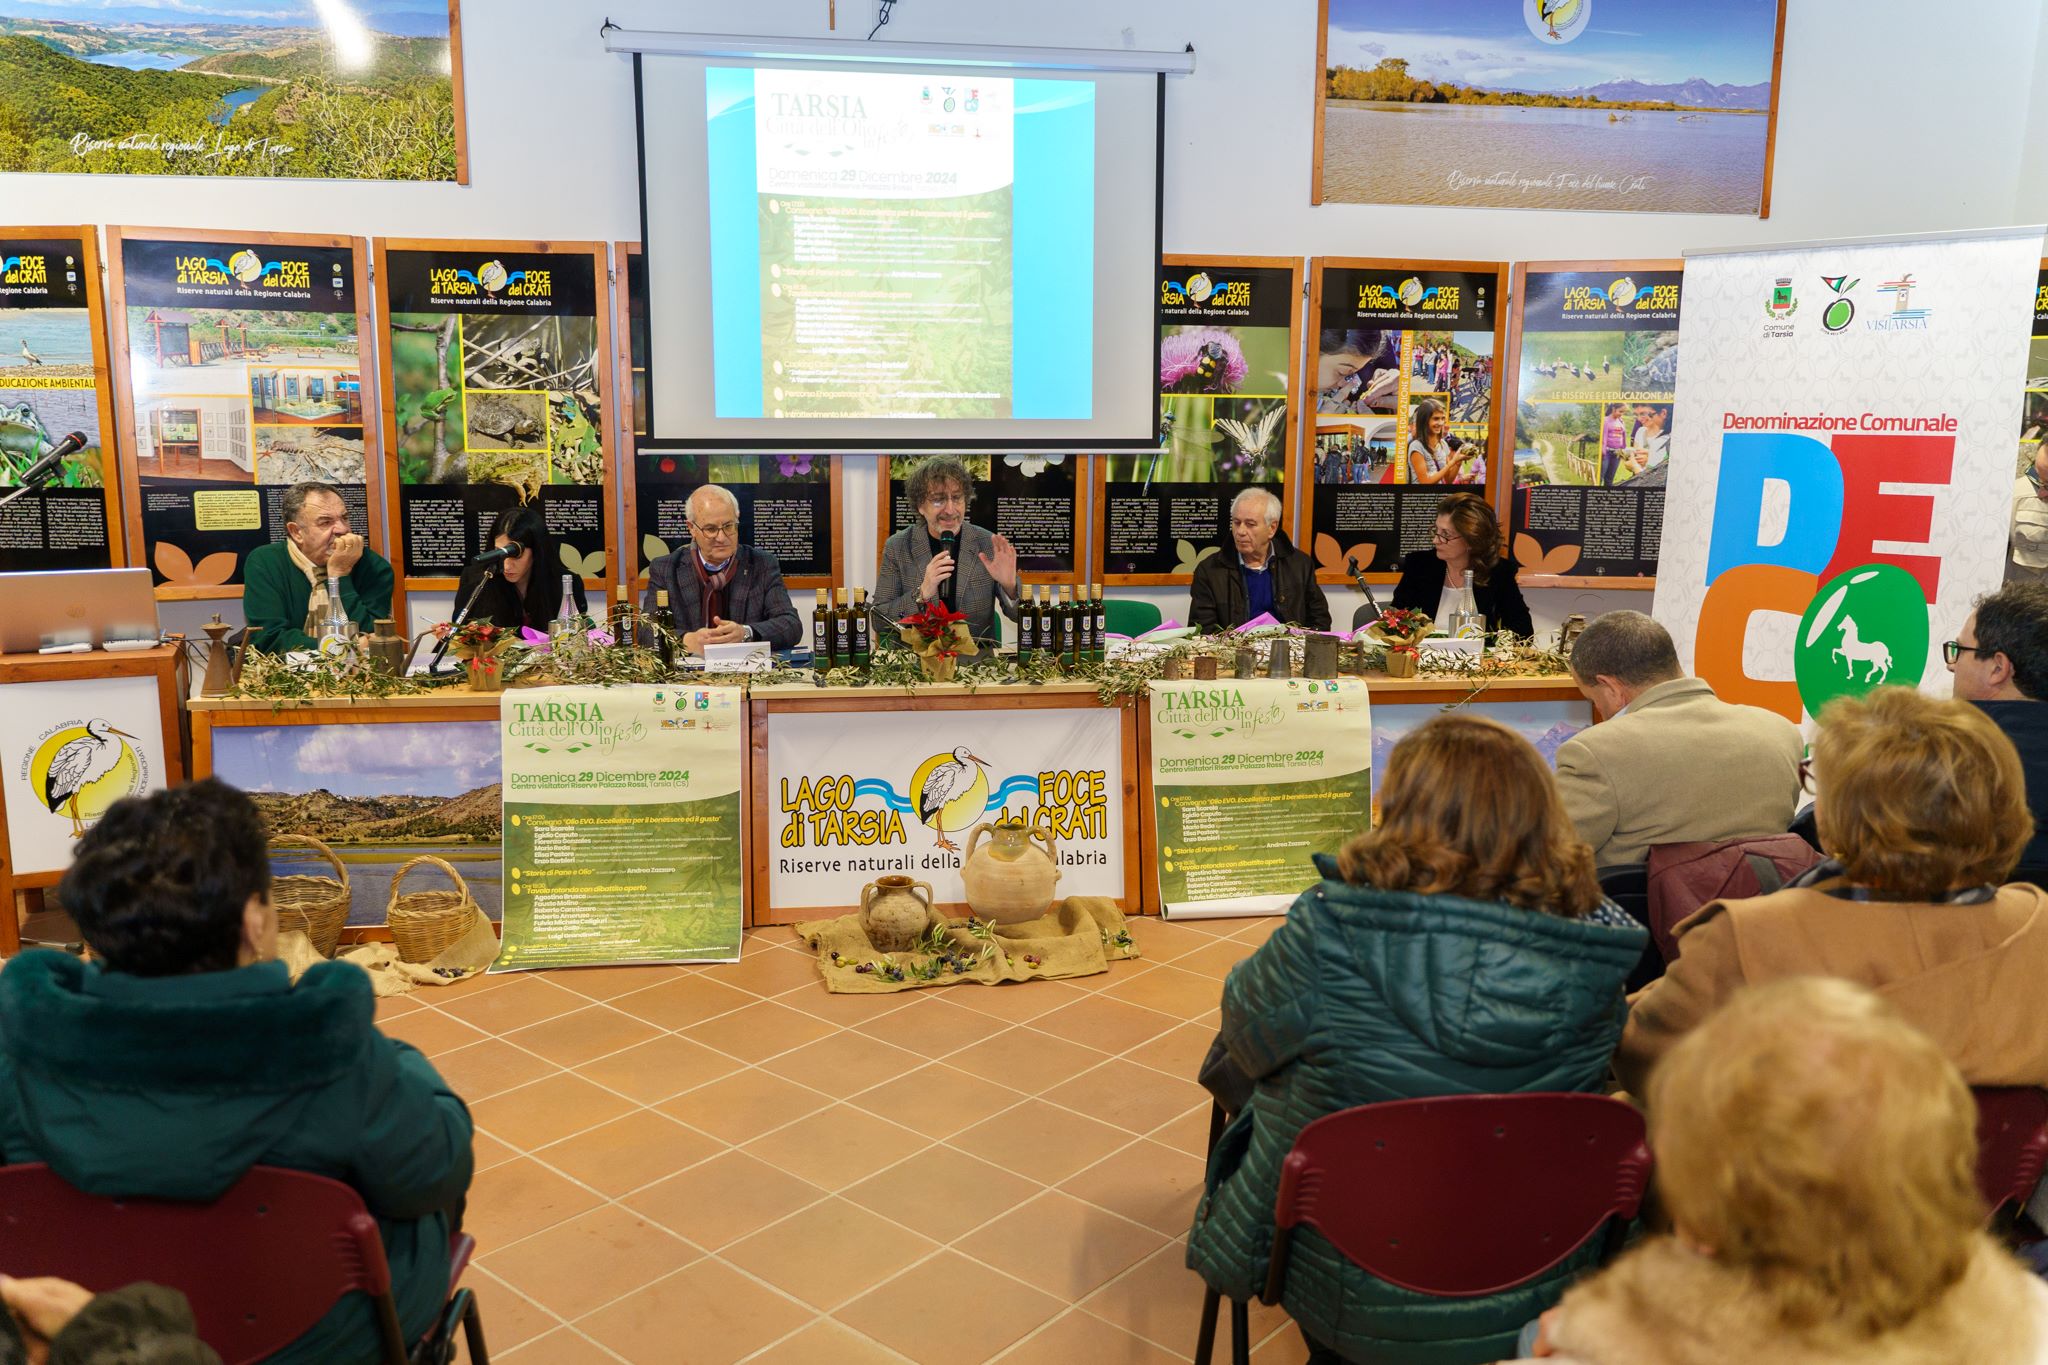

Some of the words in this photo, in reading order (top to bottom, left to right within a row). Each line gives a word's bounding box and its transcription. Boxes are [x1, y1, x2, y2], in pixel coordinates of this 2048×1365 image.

[771, 92, 868, 118] TARSIA
[840, 169, 857, 181] 29
[926, 171, 958, 184] 2024
[20, 256, 46, 270] FOCE
[176, 256, 207, 271] LAGO
[282, 261, 310, 275] FOCE
[5, 271, 19, 284] del
[19, 270, 47, 284] CRATI
[177, 272, 187, 284] di
[187, 272, 230, 285] TARSIA
[263, 274, 279, 287] del
[280, 274, 310, 288] CRATI
[430, 268, 458, 282] LAGO
[525, 271, 551, 284] FOCE
[177, 287, 203, 295] Riserve
[254, 290, 282, 299] Regione
[431, 282, 440, 294] di
[441, 282, 477, 295] TARSIA
[508, 283, 522, 295] del
[523, 283, 552, 296] CRATI
[1228, 282, 1250, 295] FOCE
[1359, 285, 1382, 298] LAGO
[1438, 287, 1460, 299] FOCE
[1564, 287, 1589, 298] LAGO
[1653, 285, 1678, 298] FOCE
[499, 299, 525, 307] Regione
[1161, 293, 1185, 305] RSIA
[1212, 294, 1224, 306] del
[1225, 294, 1250, 306] CRATI
[1357, 297, 1367, 309] di
[1367, 297, 1397, 309] TARSIA
[1422, 298, 1434, 310] del
[1435, 299, 1459, 310] CRATI
[1563, 299, 1571, 310] di
[1572, 298, 1606, 310] TARSIA
[1636, 298, 1649, 310] del
[1650, 298, 1677, 310] CRATI
[1763, 324, 1795, 332] Comune
[1402, 334, 1412, 379] AMBIENTALE
[50, 378, 96, 388] AMBIENTAL
[1552, 392, 1561, 400] LE
[1562, 392, 1595, 400] RISERVE
[1602, 391, 1660, 400] L'EDUCAZIONE
[1399, 381, 1409, 434] L'EDUCAZIONE
[1722, 412, 1857, 431] Denominazione
[1859, 412, 1958, 432] Comunale
[1397, 441, 1405, 470] RISERVE
[1161, 688, 1246, 711] TARSIA
[512, 702, 604, 721] TARSIA
[1157, 708, 1191, 724] Città
[508, 721, 545, 737] Città
[20, 744, 37, 781] REGIONE
[38, 718, 84, 741] CALABRIA
[1160, 755, 1219, 768] Domenica
[1222, 753, 1236, 765] 29
[1238, 751, 1293, 763] Dicembre
[1295, 749, 1325, 761] 2024
[1287, 760, 1307, 768] Tarsia
[1308, 759, 1325, 767] (CS)
[511, 772, 576, 783] Domenica
[578, 771, 594, 782] 29
[596, 771, 657, 782] Dicembre
[658, 770, 690, 782] 2024
[650, 780, 672, 788] Tarsia
[673, 780, 690, 788] (CS)
[1037, 769, 1107, 806] FOCE
[781, 774, 857, 814] LAGO
[527, 818, 563, 826] Convegno
[781, 811, 804, 848] di
[808, 808, 908, 847] TARSIA
[1032, 805, 1108, 840] CRATI
[780, 856, 842, 874] Riserve
[847, 854, 915, 872] naturali
[920, 851, 962, 870] della
[1056, 849, 1107, 866] labria
